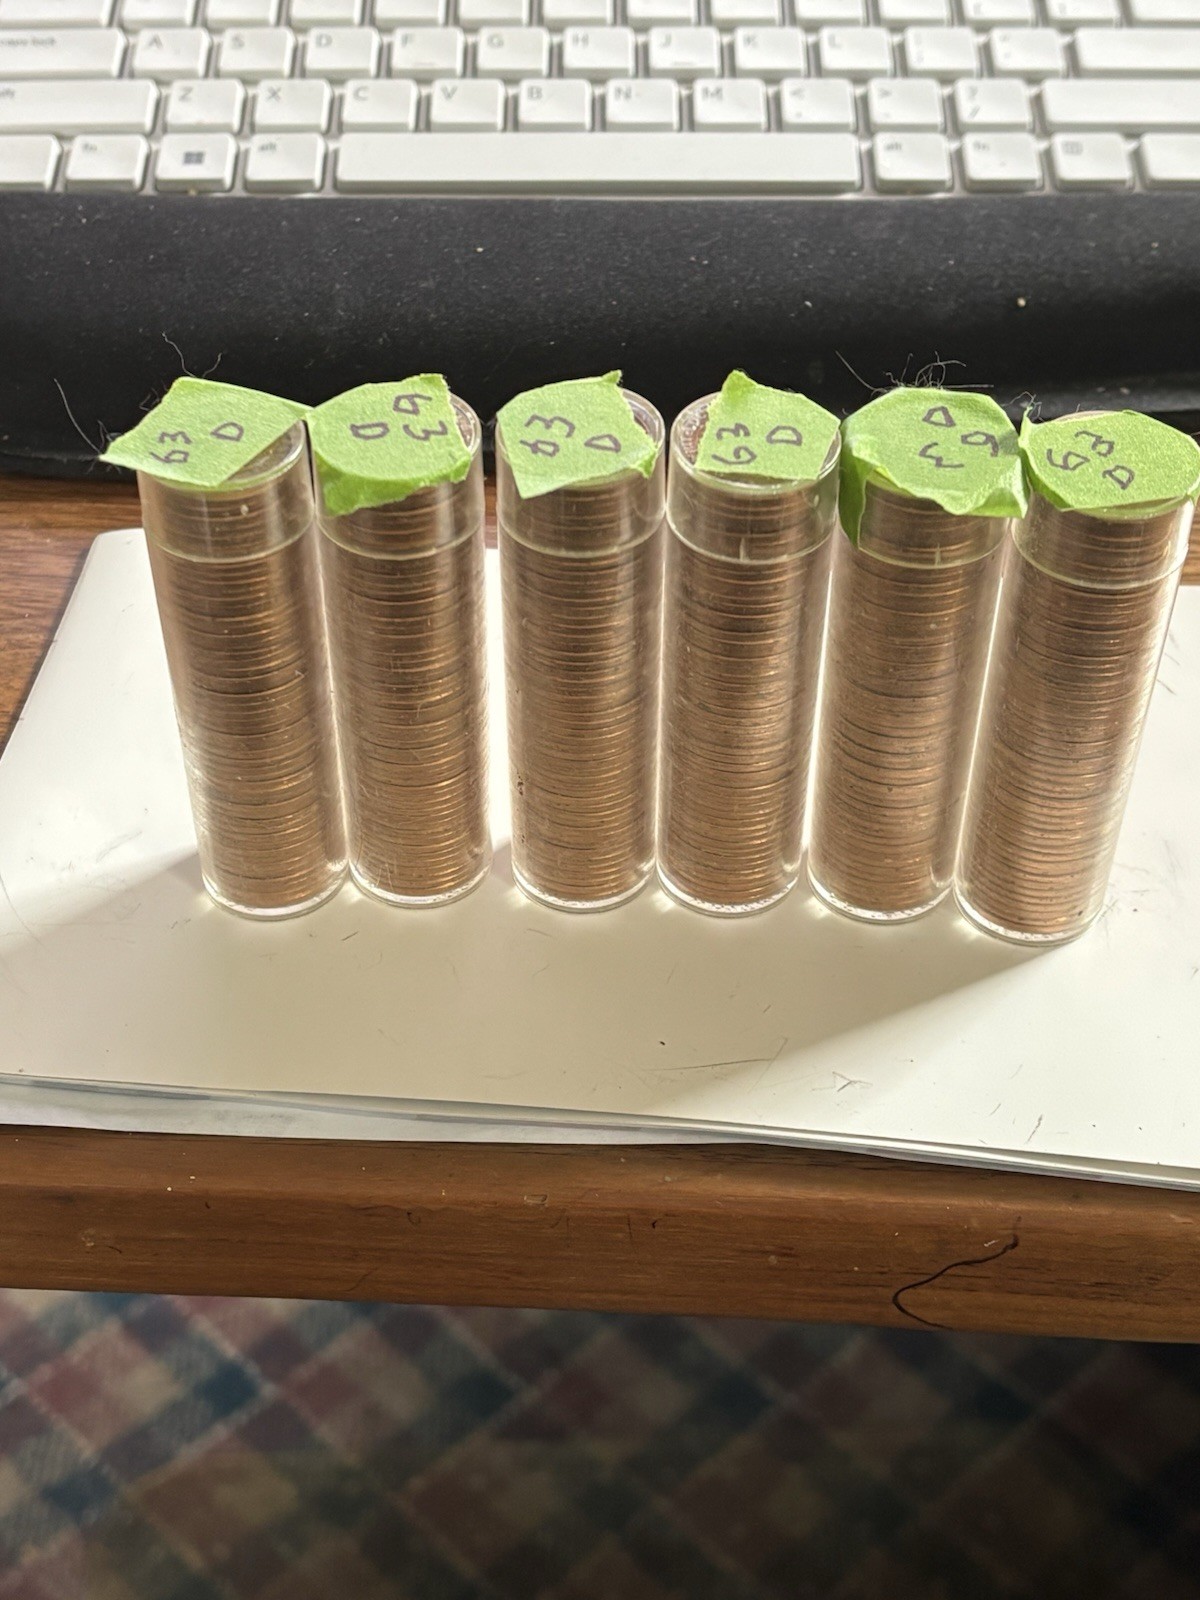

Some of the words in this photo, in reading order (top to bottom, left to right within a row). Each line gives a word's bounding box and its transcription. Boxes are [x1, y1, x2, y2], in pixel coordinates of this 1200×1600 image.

[148, 35, 164, 49] A
[231, 35, 245, 50] S
[316, 34, 333, 49] D
[401, 34, 414, 48] F
[487, 34, 504, 48] G
[573, 34, 590, 48] H
[660, 34, 673, 48] J
[743, 34, 759, 48] K
[828, 34, 842, 49] L
[178, 87, 193, 102] Z
[266, 87, 282, 102] X
[353, 86, 369, 102] C
[441, 86, 458, 101] V
[527, 86, 543, 101] B
[614, 86, 632, 101] N
[702, 87, 723, 102] M
[393, 393, 448, 441] 63
[922, 405, 956, 427] D
[211, 422, 244, 442] D
[350, 421, 390, 440] D
[519, 414, 576, 458] 63
[766, 425, 803, 447] D
[150, 431, 192, 463] 63
[584, 433, 622, 453] D
[711, 422, 758, 465] 63
[919, 430, 999, 469] 63
[1046, 430, 1115, 471] 63
[1102, 465, 1136, 491] D
